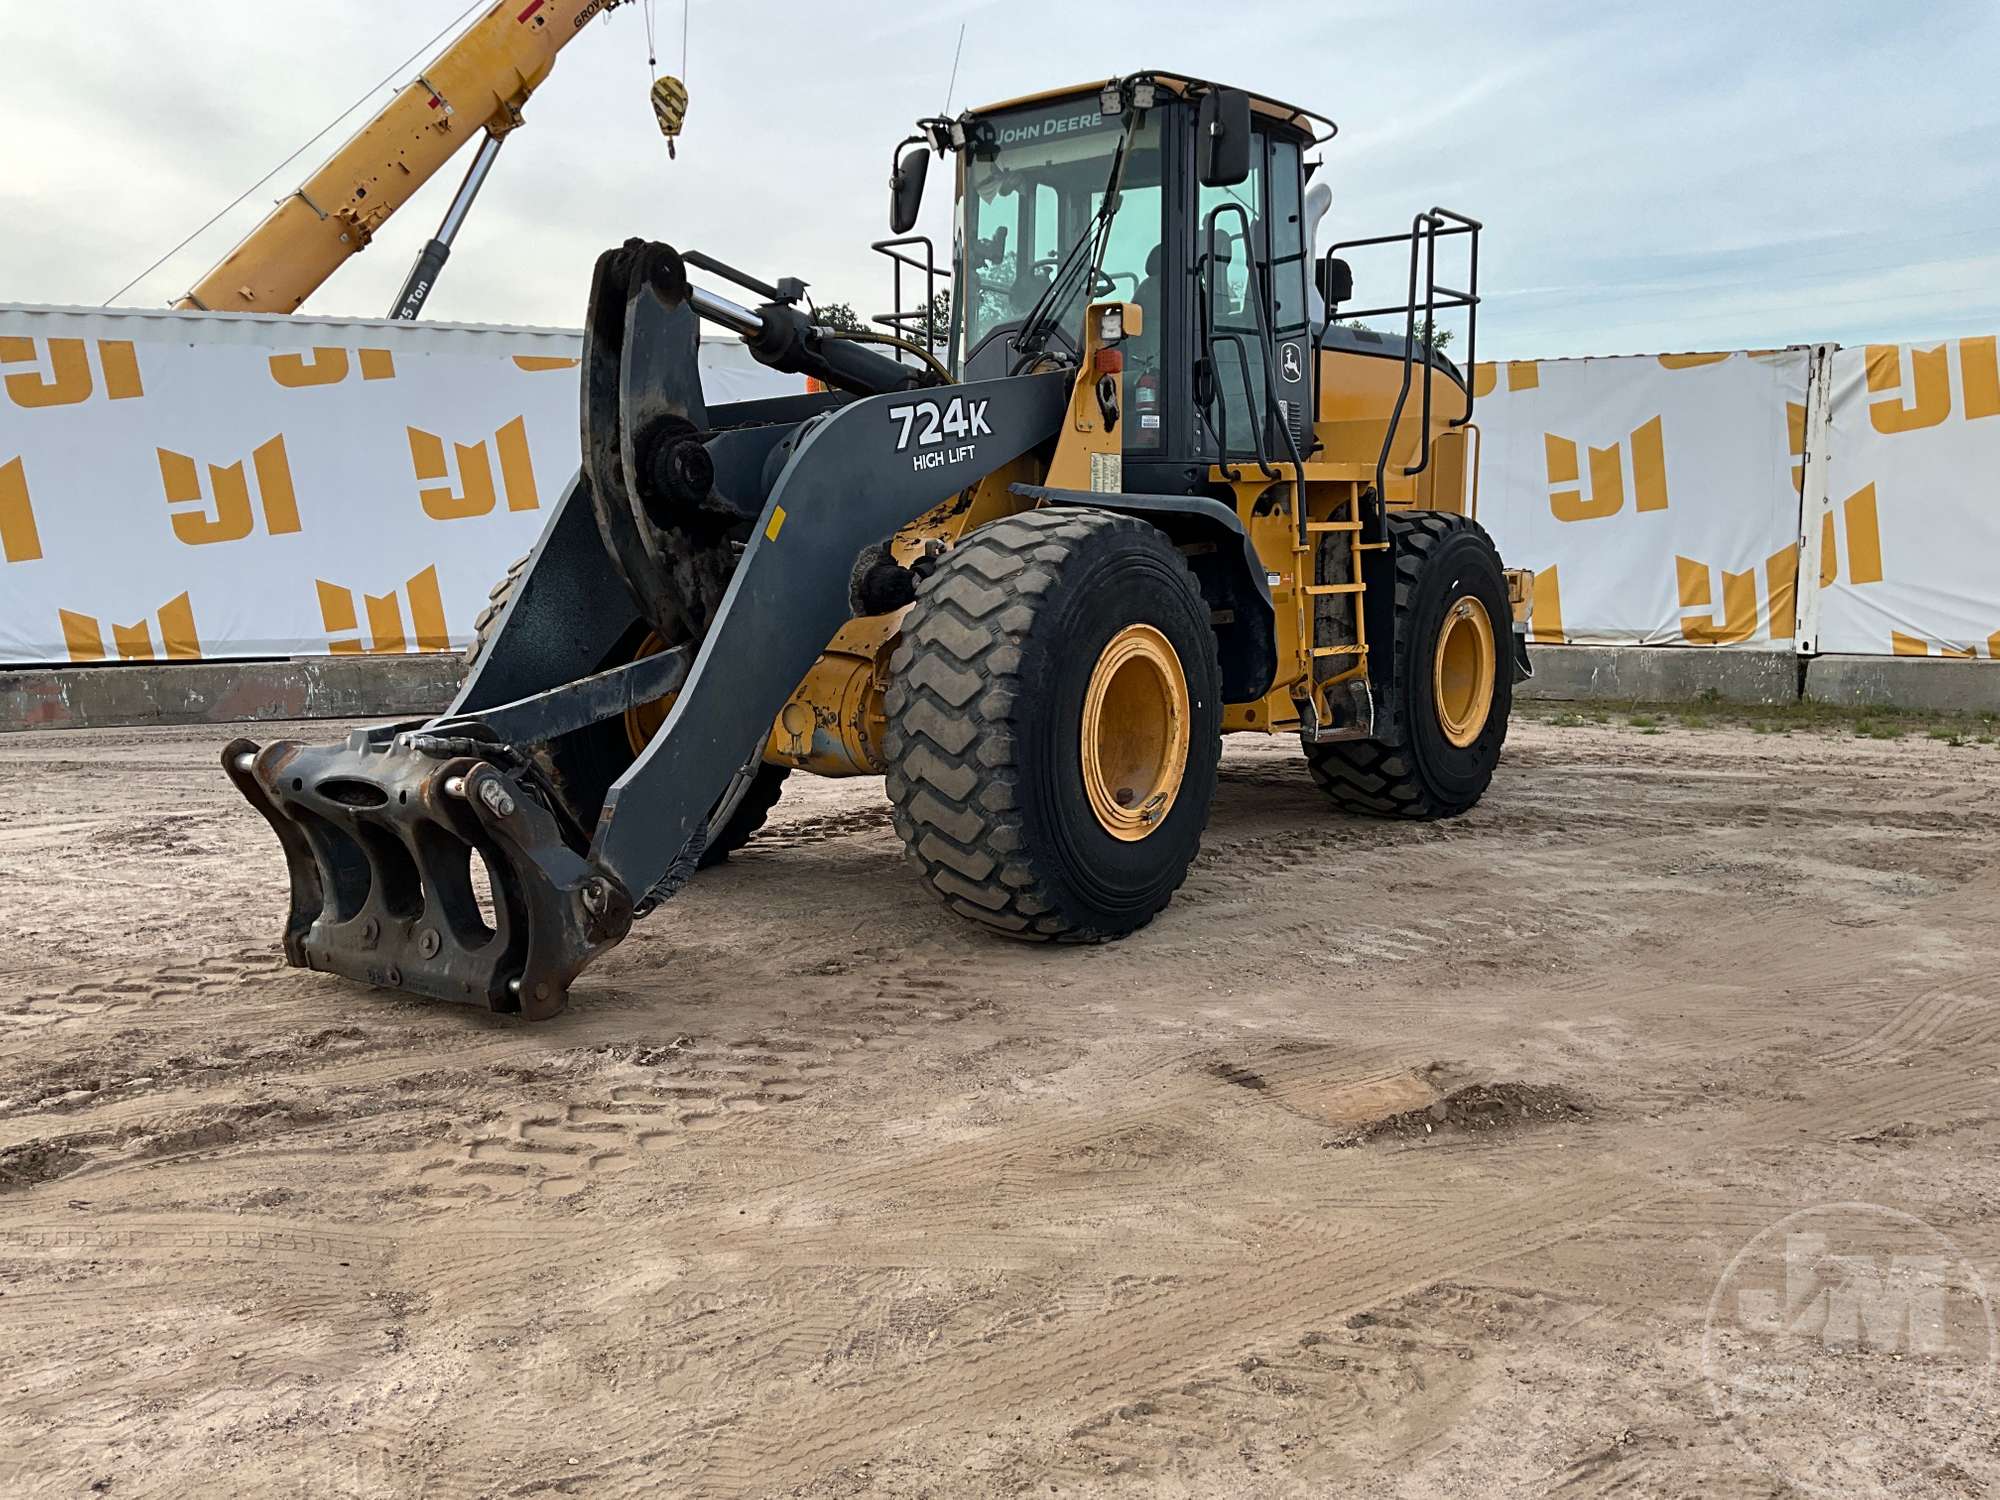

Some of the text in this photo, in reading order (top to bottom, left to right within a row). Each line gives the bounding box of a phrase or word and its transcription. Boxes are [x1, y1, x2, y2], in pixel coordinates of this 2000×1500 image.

[574, 0, 604, 28] GROV
[996, 112, 1103, 144] JOHN DEERE
[407, 281, 428, 305] Ton
[890, 397, 992, 449] 724K
[913, 445, 976, 471] HIGH LIFT
